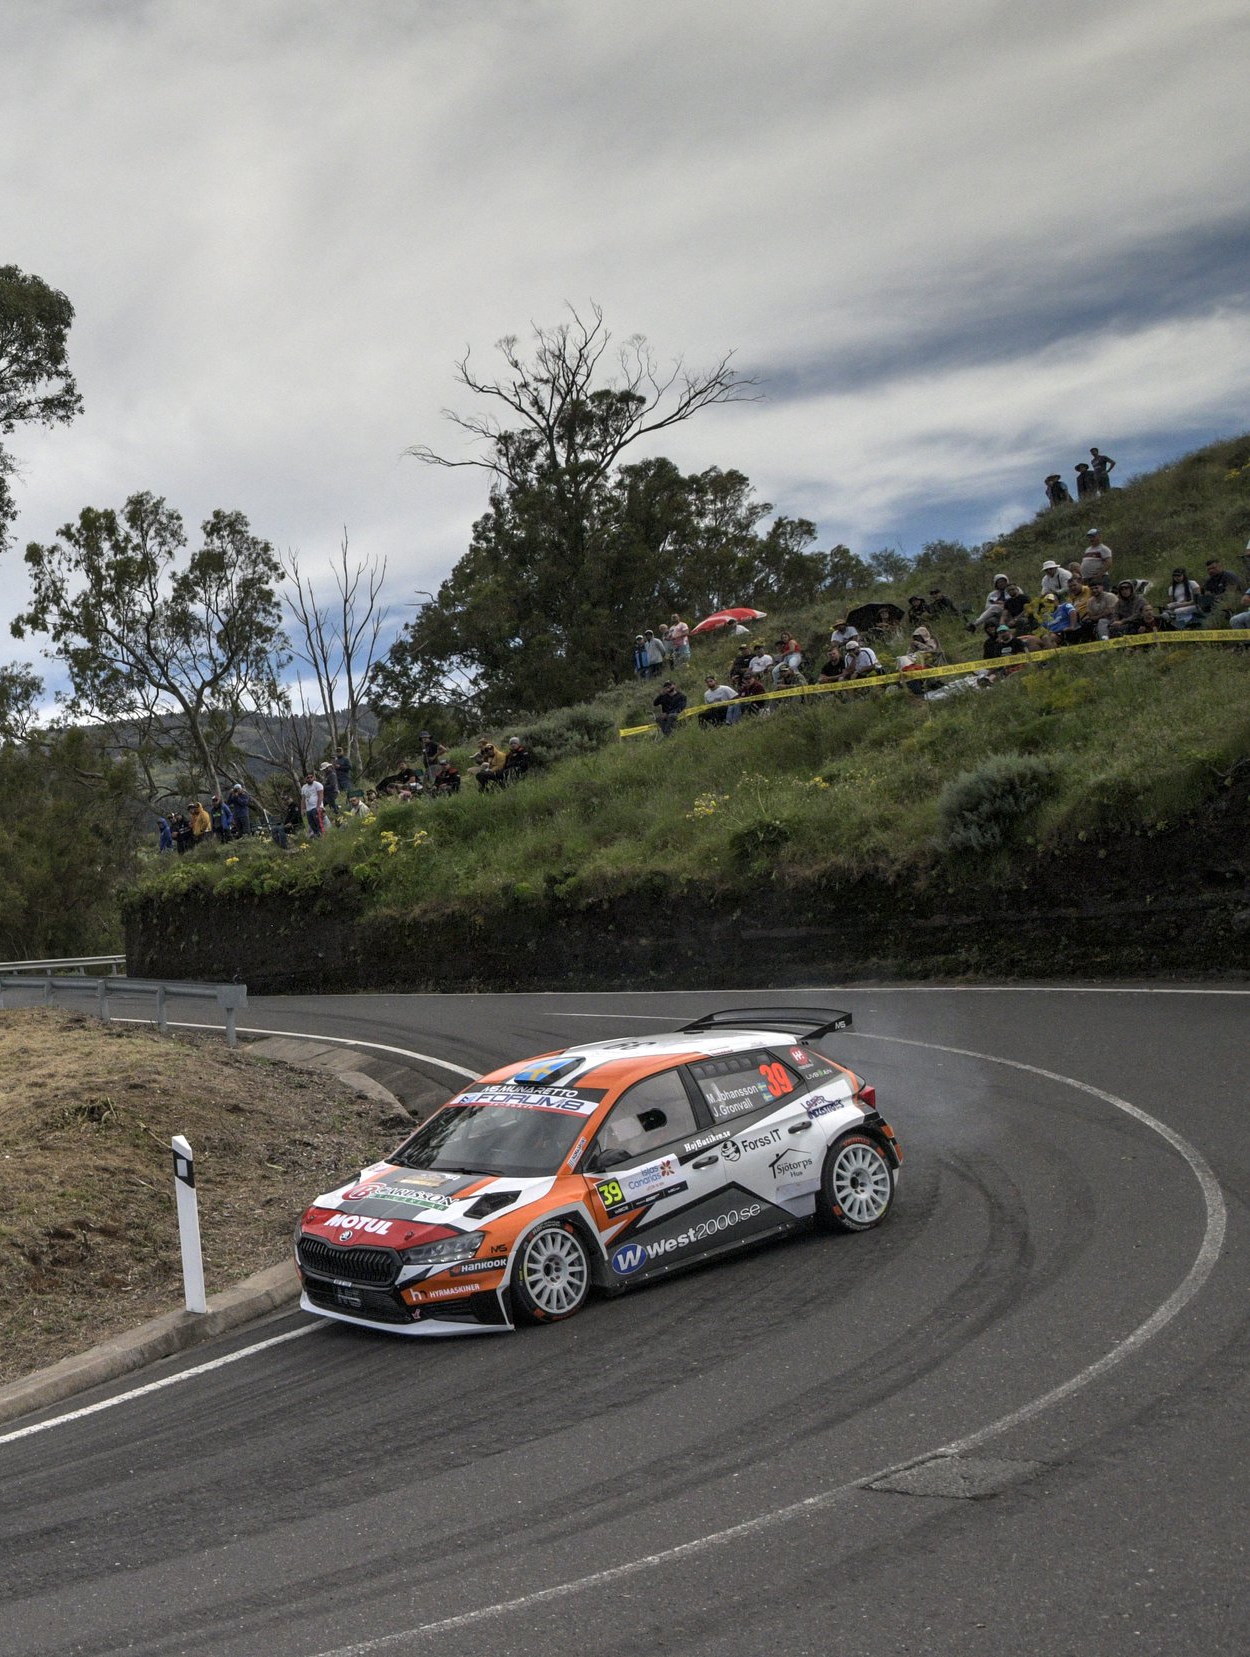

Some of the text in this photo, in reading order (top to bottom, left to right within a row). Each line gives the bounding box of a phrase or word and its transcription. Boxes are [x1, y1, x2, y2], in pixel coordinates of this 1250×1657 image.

[759, 1062, 795, 1098] 39
[474, 1093, 585, 1111] FORUM8
[499, 1085, 579, 1099] MUNARETTO
[706, 1084, 759, 1104] M.Johansson
[741, 1128, 783, 1153] Forss IT
[628, 1172, 662, 1189] Canarias
[375, 1187, 460, 1206] CARLSSON
[598, 1181, 623, 1206] 39
[323, 1214, 394, 1236] MOTUL
[646, 1203, 761, 1260] West2000.se
[429, 1283, 481, 1298] HYRMASKINER
